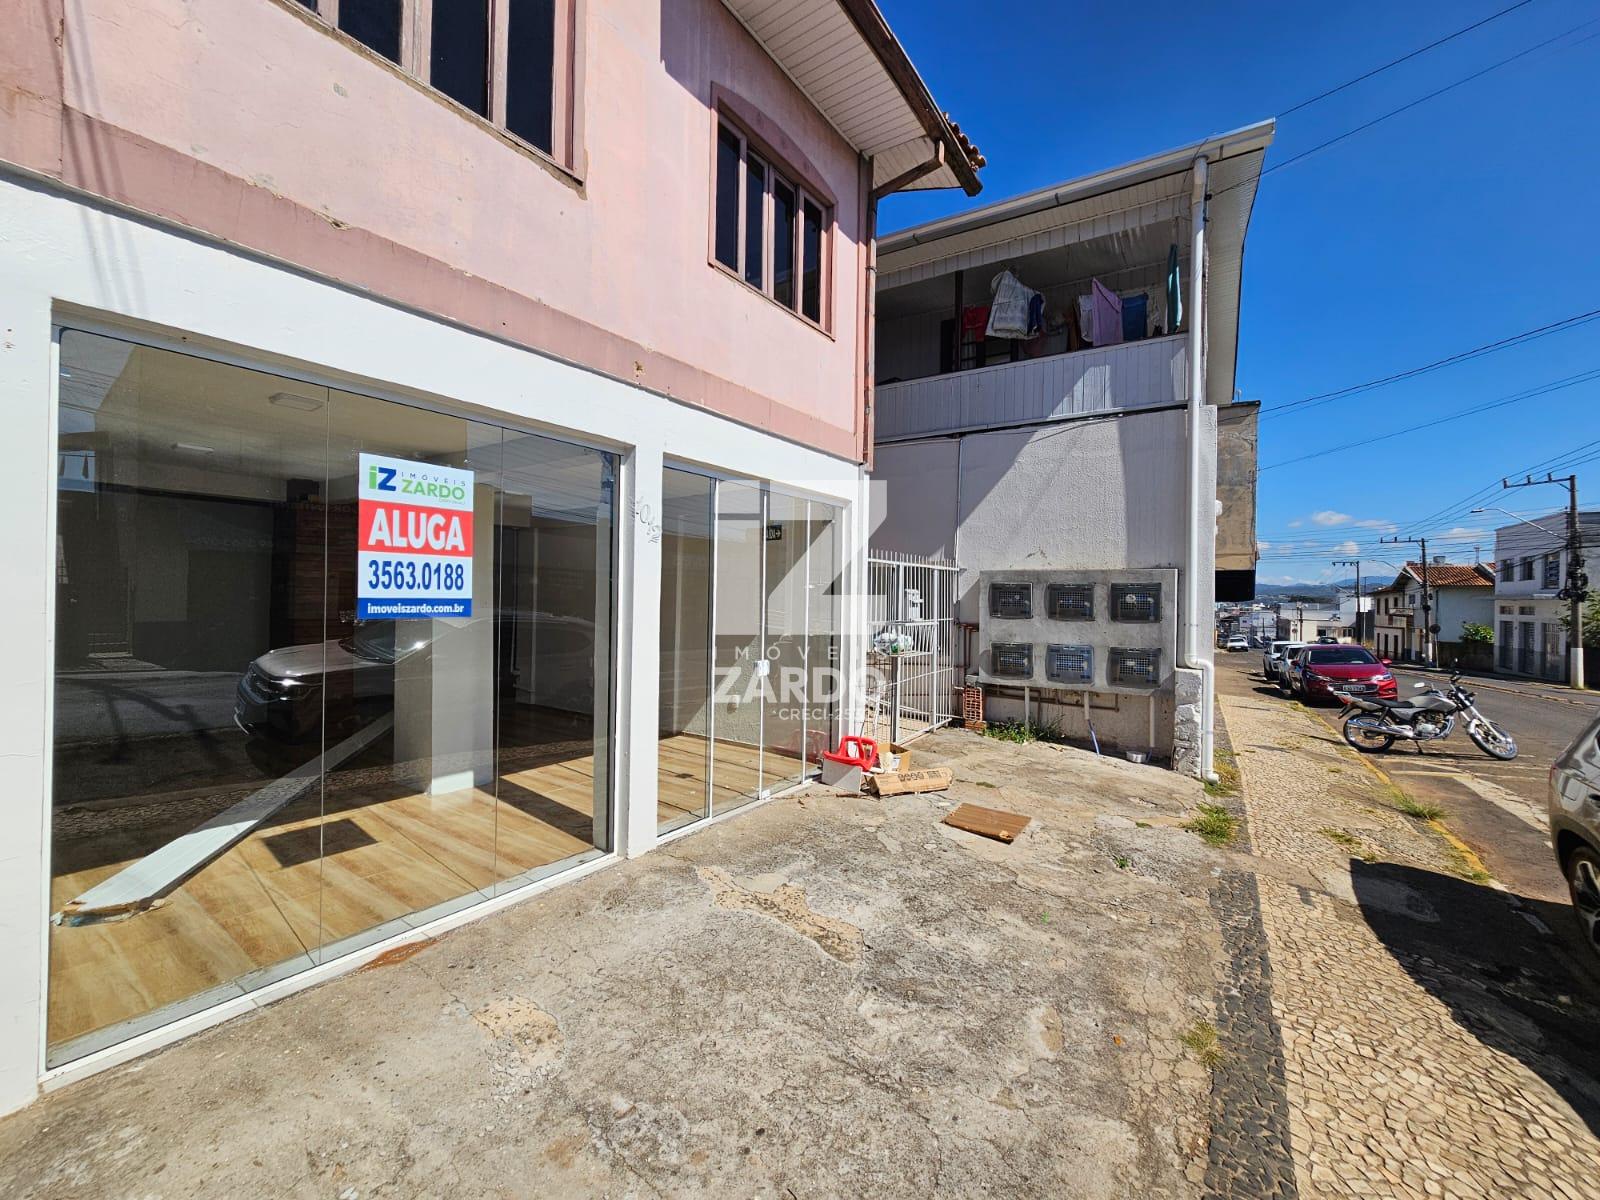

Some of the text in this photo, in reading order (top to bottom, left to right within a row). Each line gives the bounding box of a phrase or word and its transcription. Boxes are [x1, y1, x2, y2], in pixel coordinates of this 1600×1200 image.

[402, 479, 465, 500] ZARDO
[368, 508, 465, 551] ALUGA
[368, 560, 464, 591] 3563.0188
[367, 603, 464, 614] imoveiszardo.com.br
